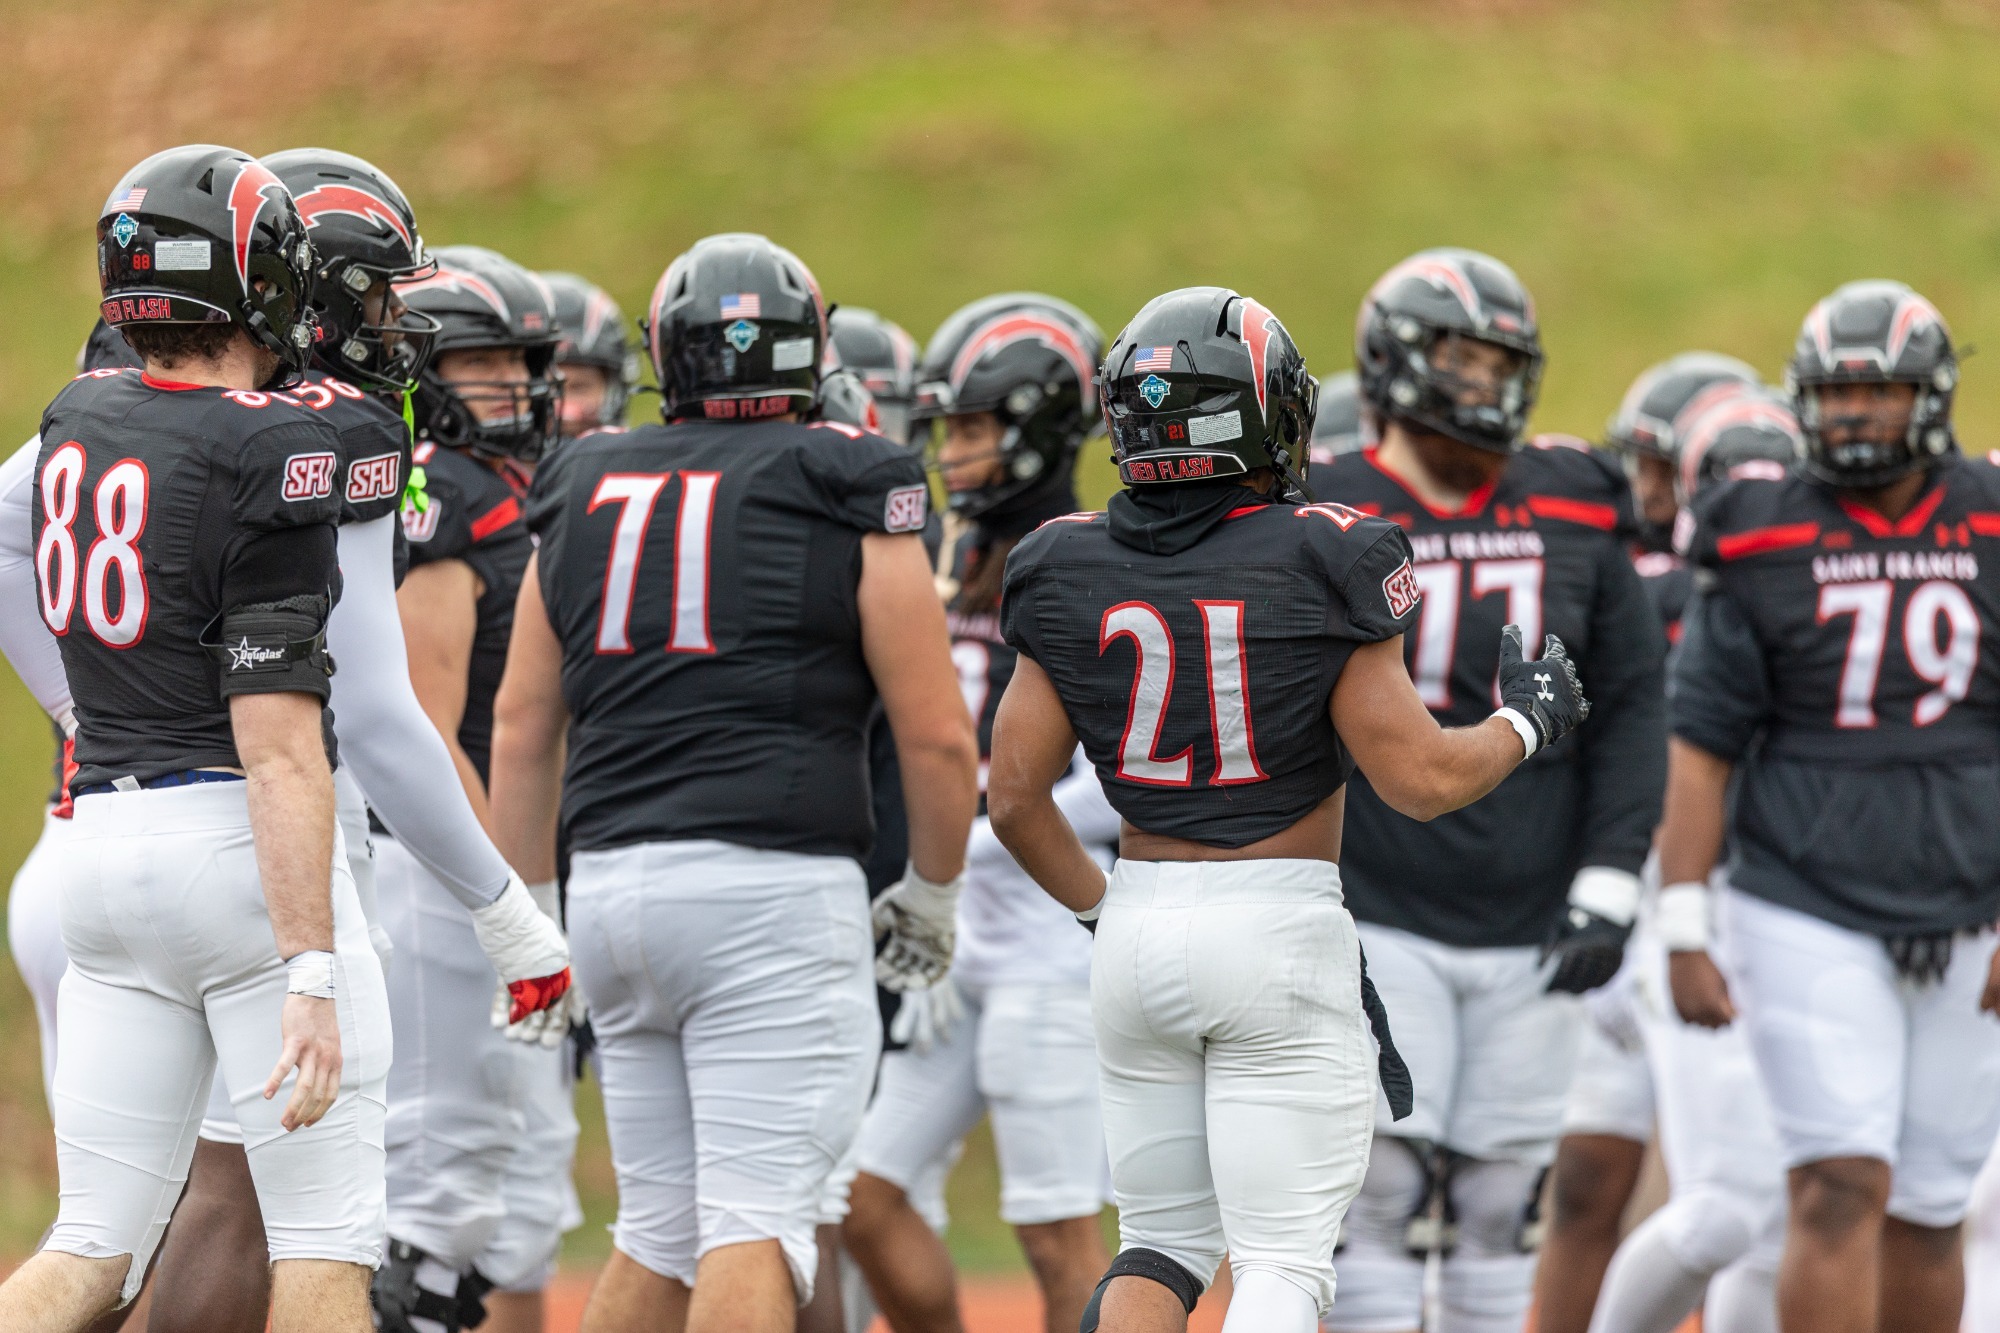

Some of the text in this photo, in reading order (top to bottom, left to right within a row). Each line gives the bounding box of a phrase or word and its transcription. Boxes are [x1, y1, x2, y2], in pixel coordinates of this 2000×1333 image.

[132, 254, 150, 270] 88
[122, 298, 171, 319] FLASH
[1144, 385, 1165, 393] FCS
[704, 396, 791, 418] RED FLASH
[1167, 424, 1184, 439] 21
[284, 455, 335, 499] SFU
[348, 455, 398, 499] SFU
[1129, 456, 1214, 480] RED FLASH
[888, 488, 925, 529] SFU
[36, 441, 150, 650] 88
[586, 470, 723, 654] 71
[1885, 552, 1979, 580] FRANCIS
[1815, 578, 1983, 729] 79
[1099, 599, 1271, 787] 21
